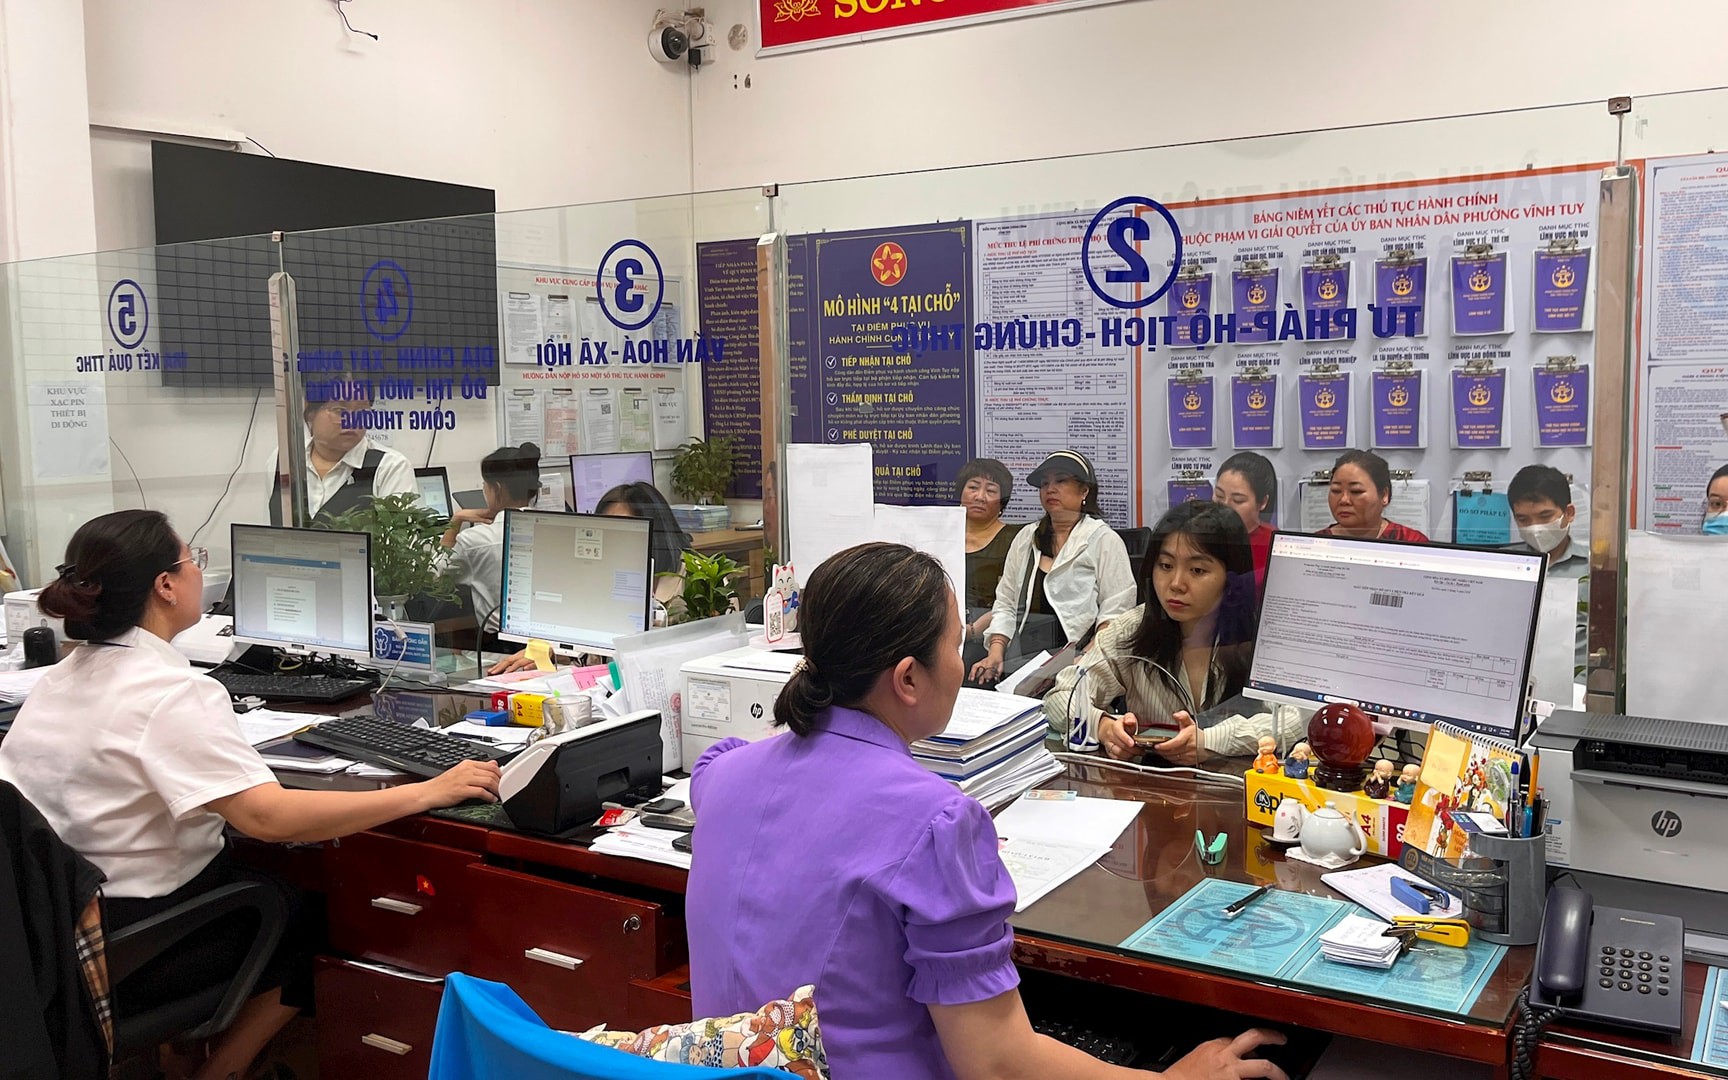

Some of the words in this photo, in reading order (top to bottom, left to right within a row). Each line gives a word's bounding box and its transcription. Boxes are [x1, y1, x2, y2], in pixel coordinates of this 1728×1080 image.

[1254, 209, 1283, 224] BẢNG
[1286, 207, 1313, 221] NIÊM
[1317, 202, 1333, 218] YẾT
[1338, 201, 1358, 216] CÁC
[1363, 199, 1387, 215] THỦ
[1391, 199, 1413, 216] TỤC
[1418, 194, 1453, 210] HÀNH
[1456, 191, 1498, 207] CHÍNH
[1181, 231, 1211, 247] HUỘC
[1215, 231, 1245, 246] PHẠM
[1248, 229, 1258, 240] VI
[1261, 225, 1283, 239] GIẢI
[1286, 219, 1321, 237] QUYẾT
[1325, 220, 1347, 234] CỦA
[1350, 218, 1366, 232] ỦY
[1369, 218, 1392, 231] BAN
[1396, 214, 1430, 228] NHÂN
[1434, 210, 1459, 225] DÂN
[1463, 205, 1519, 223] PHƯỜNG
[1523, 202, 1555, 218] VĨNH
[1561, 202, 1585, 216] TUY
[987, 240, 1001, 249] MỨC
[1019, 239, 1026, 249] LỆ
[1028, 238, 1040, 247] PHÍ
[1042, 236, 1066, 246] CHỨNG
[824, 294, 845, 317] MÔ
[847, 293, 880, 316] HÌNH
[901, 295, 921, 318] TẠI
[851, 324, 864, 333] TẠI
[829, 334, 853, 344] HÀNH
[855, 333, 882, 343] CHÍNH
[842, 355, 857, 367] TIẾP
[859, 355, 880, 368] NHẬN
[882, 356, 893, 368] TẠI
[47, 387, 65, 396] KHU
[67, 387, 87, 397] VỰC
[842, 391, 862, 403] THẨM
[884, 392, 896, 405] TẠI
[77, 409, 86, 418] BỊ
[62, 419, 87, 429] ĐỘNG
[843, 428, 857, 440] PHÊ
[859, 428, 881, 441] DUYỆT
[883, 430, 895, 442] TẠI
[875, 465, 890, 477] QUẢ
[892, 466, 903, 478] TẠI
[751, 703, 763, 719] hp
[1360, 814, 1371, 837] A4
[1652, 810, 1681, 838] hp
